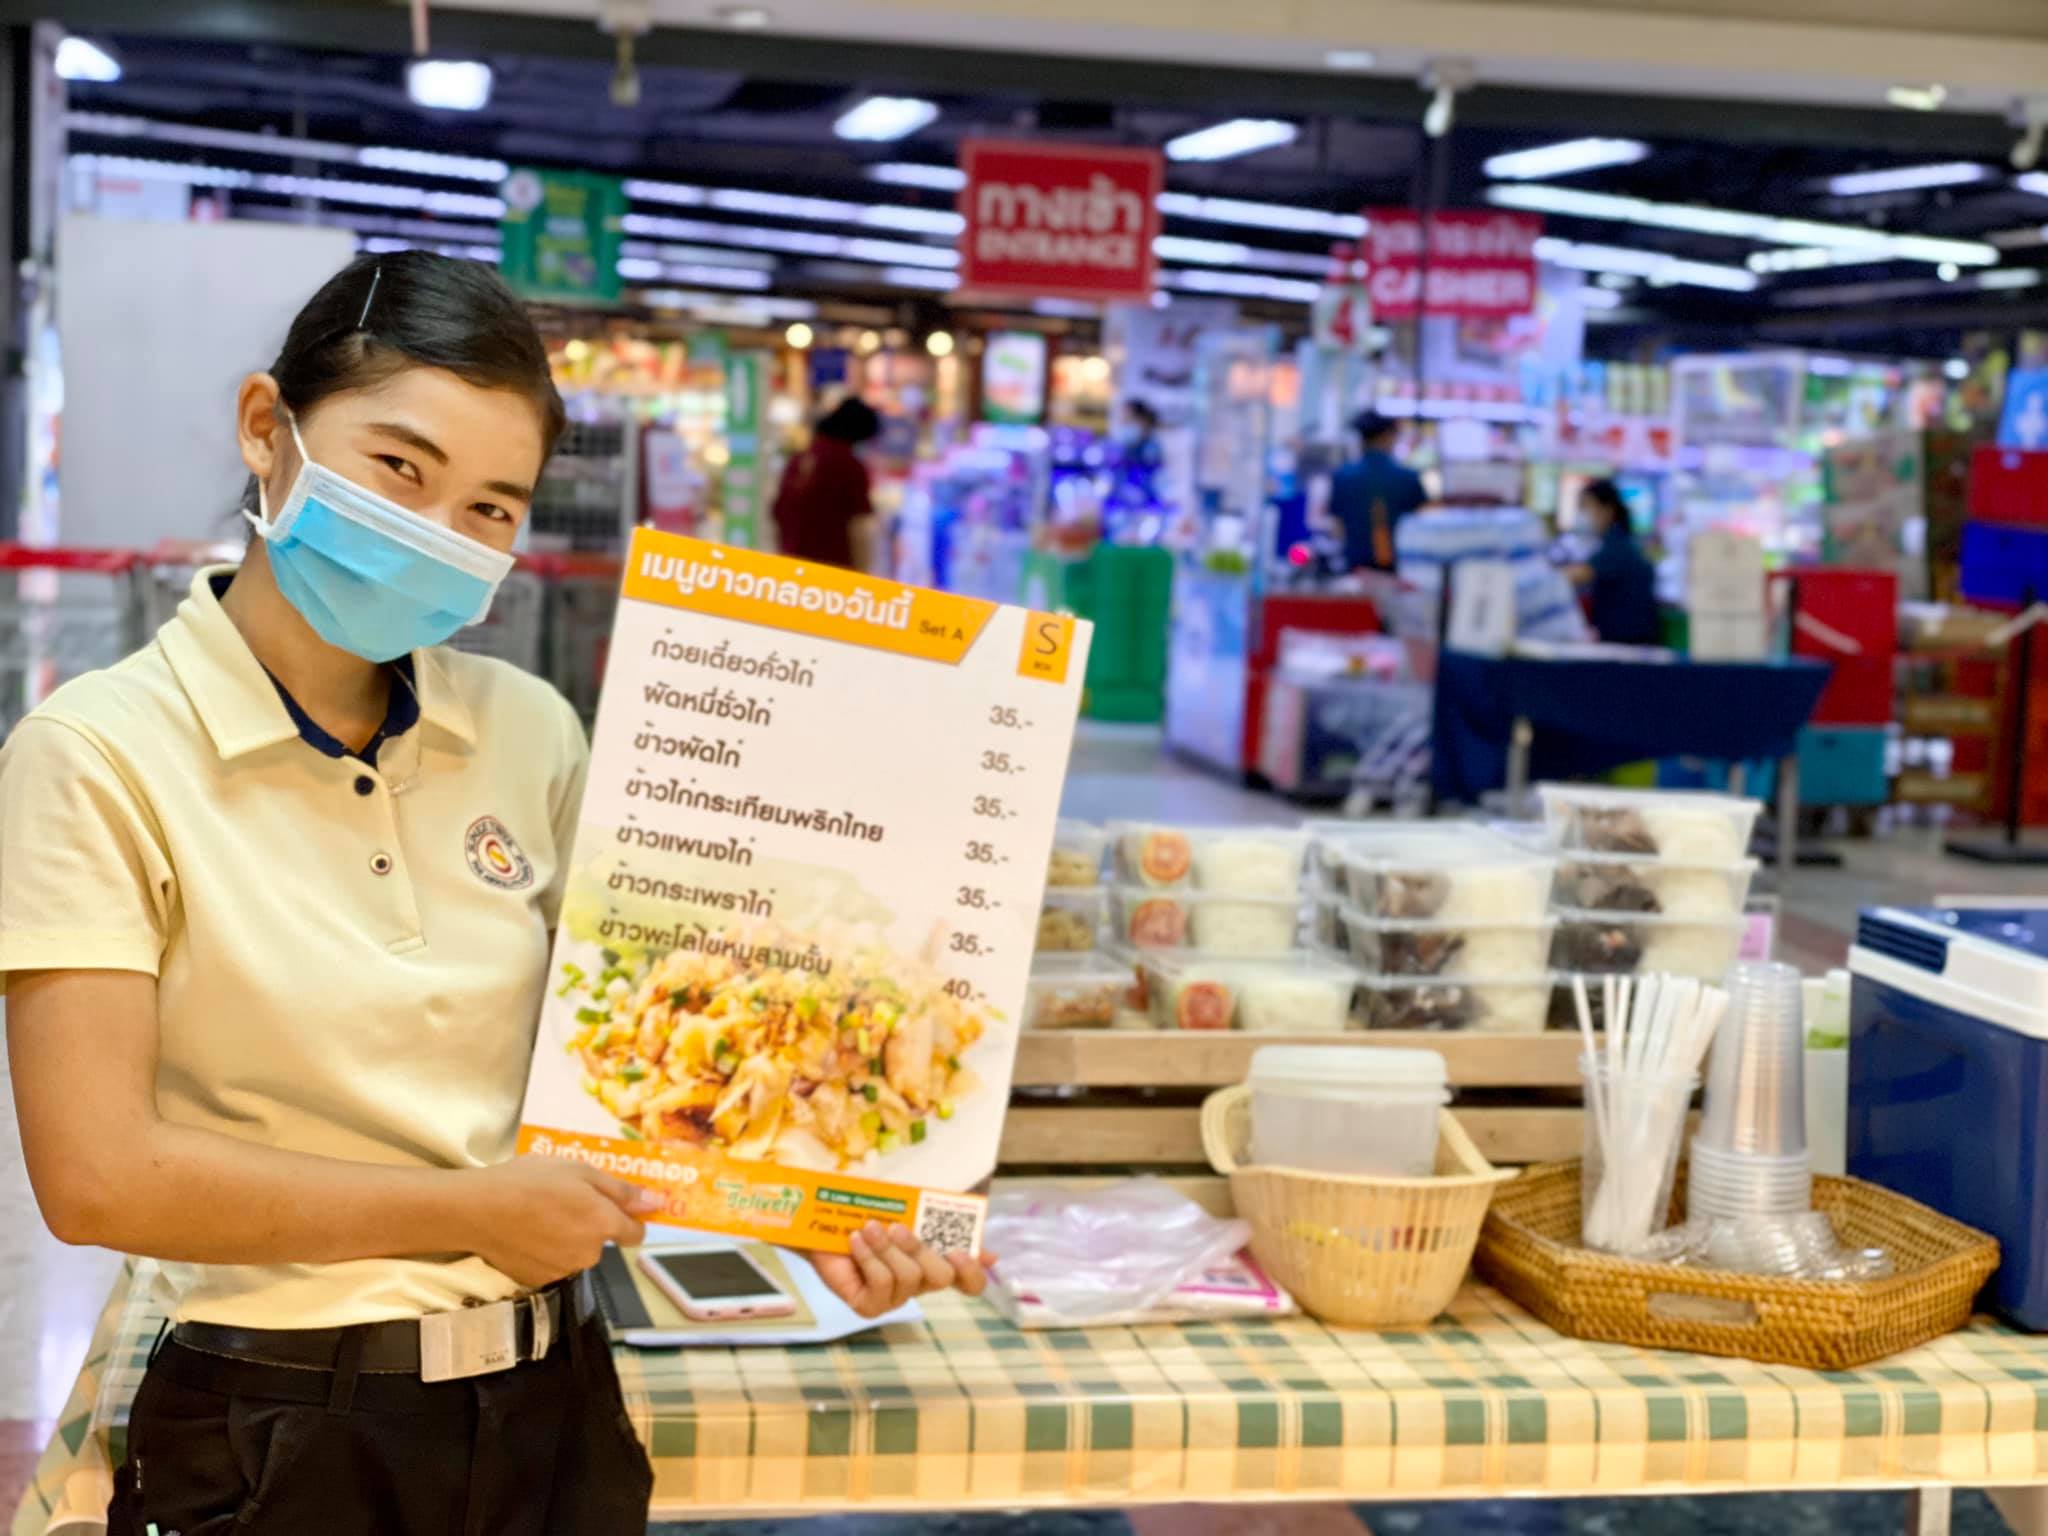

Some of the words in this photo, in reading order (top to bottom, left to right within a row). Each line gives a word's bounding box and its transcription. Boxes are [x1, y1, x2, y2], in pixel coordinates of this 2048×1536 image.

[976, 171, 1143, 232] ทางเข้า
[976, 227, 1138, 269] ENTRANCE
[640, 549, 915, 630] เมนูข้าวกล่องวันนี้
[919, 620, 946, 638] Set
[951, 628, 964, 641] A
[1035, 621, 1061, 655] S
[988, 705, 1034, 730] 35.-
[633, 720, 744, 769] ข้าวผัดไก่
[972, 795, 1018, 820] 35.-
[980, 750, 1026, 775] 35.-
[624, 767, 885, 842] ข้าวไก่กระเทียมพริกไทย
[964, 840, 1010, 865] 35.-
[615, 813, 756, 867] ข้าวแพนงไก่
[956, 886, 1002, 910] 35.-
[607, 860, 776, 918] ข้าวกระเพราไก่
[949, 932, 995, 956] 35.-
[941, 978, 987, 1002] 40.-
